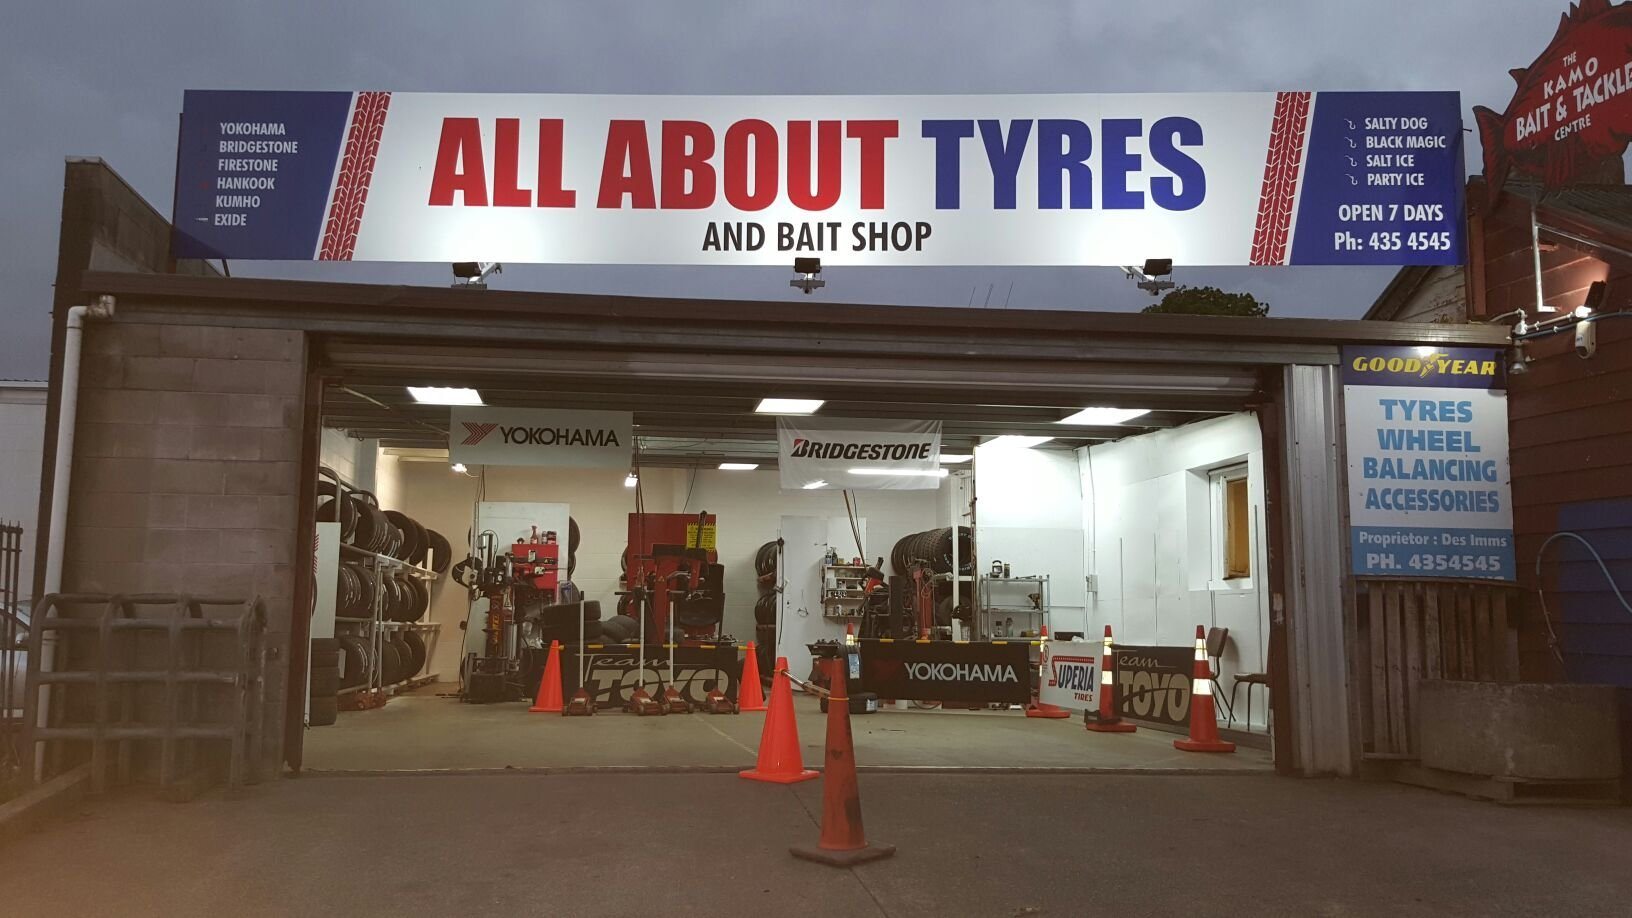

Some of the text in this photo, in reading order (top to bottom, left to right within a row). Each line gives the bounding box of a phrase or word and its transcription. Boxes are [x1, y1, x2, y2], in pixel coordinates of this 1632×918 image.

[1563, 51, 1577, 68] THE
[1543, 57, 1598, 99] KAMO
[1516, 62, 1632, 142] BAIT & TACKLE
[219, 122, 286, 136] YOKOHAMA
[1365, 117, 1428, 130] SALTY DOG
[1554, 114, 1592, 141] CENTRE
[219, 141, 298, 154] BRIDGESTONE
[1366, 135, 1447, 149] BLACK MAGIC
[218, 158, 279, 172] FIRESTONE
[428, 116, 1207, 212] ALL ABOUT TYRES
[1366, 154, 1415, 167] SALT ICE
[216, 176, 276, 190] HANKOOK
[1367, 173, 1425, 186] PARTY ICE
[215, 195, 261, 208] KUMHO
[214, 213, 248, 226] EXIDE
[1338, 204, 1444, 222] OPEN 7 DAYS
[702, 221, 932, 252] AND BAIT SHOP
[1334, 231, 1451, 250] Ph: 435 4545
[1379, 398, 1473, 424] TYRES
[500, 426, 620, 447] YOKOHAMA
[1377, 428, 1481, 453] WHEEL
[791, 438, 932, 461] BRIDGESTONE
[1363, 457, 1498, 483] BALANCING
[1365, 487, 1500, 513] ACCESSORIES
[1359, 531, 1429, 548] Proprietor
[1442, 533, 1467, 546] Des
[1470, 534, 1508, 547] Imms
[1366, 553, 1501, 571] PH. 4354545
[576, 653, 676, 682] Team
[904, 662, 1019, 683] YOKOHAMA
[1048, 656, 1095, 692] SUPERIA
[592, 668, 729, 703] TOYO
[1074, 692, 1093, 702] TIRES
[1119, 671, 1191, 722] TOYO
